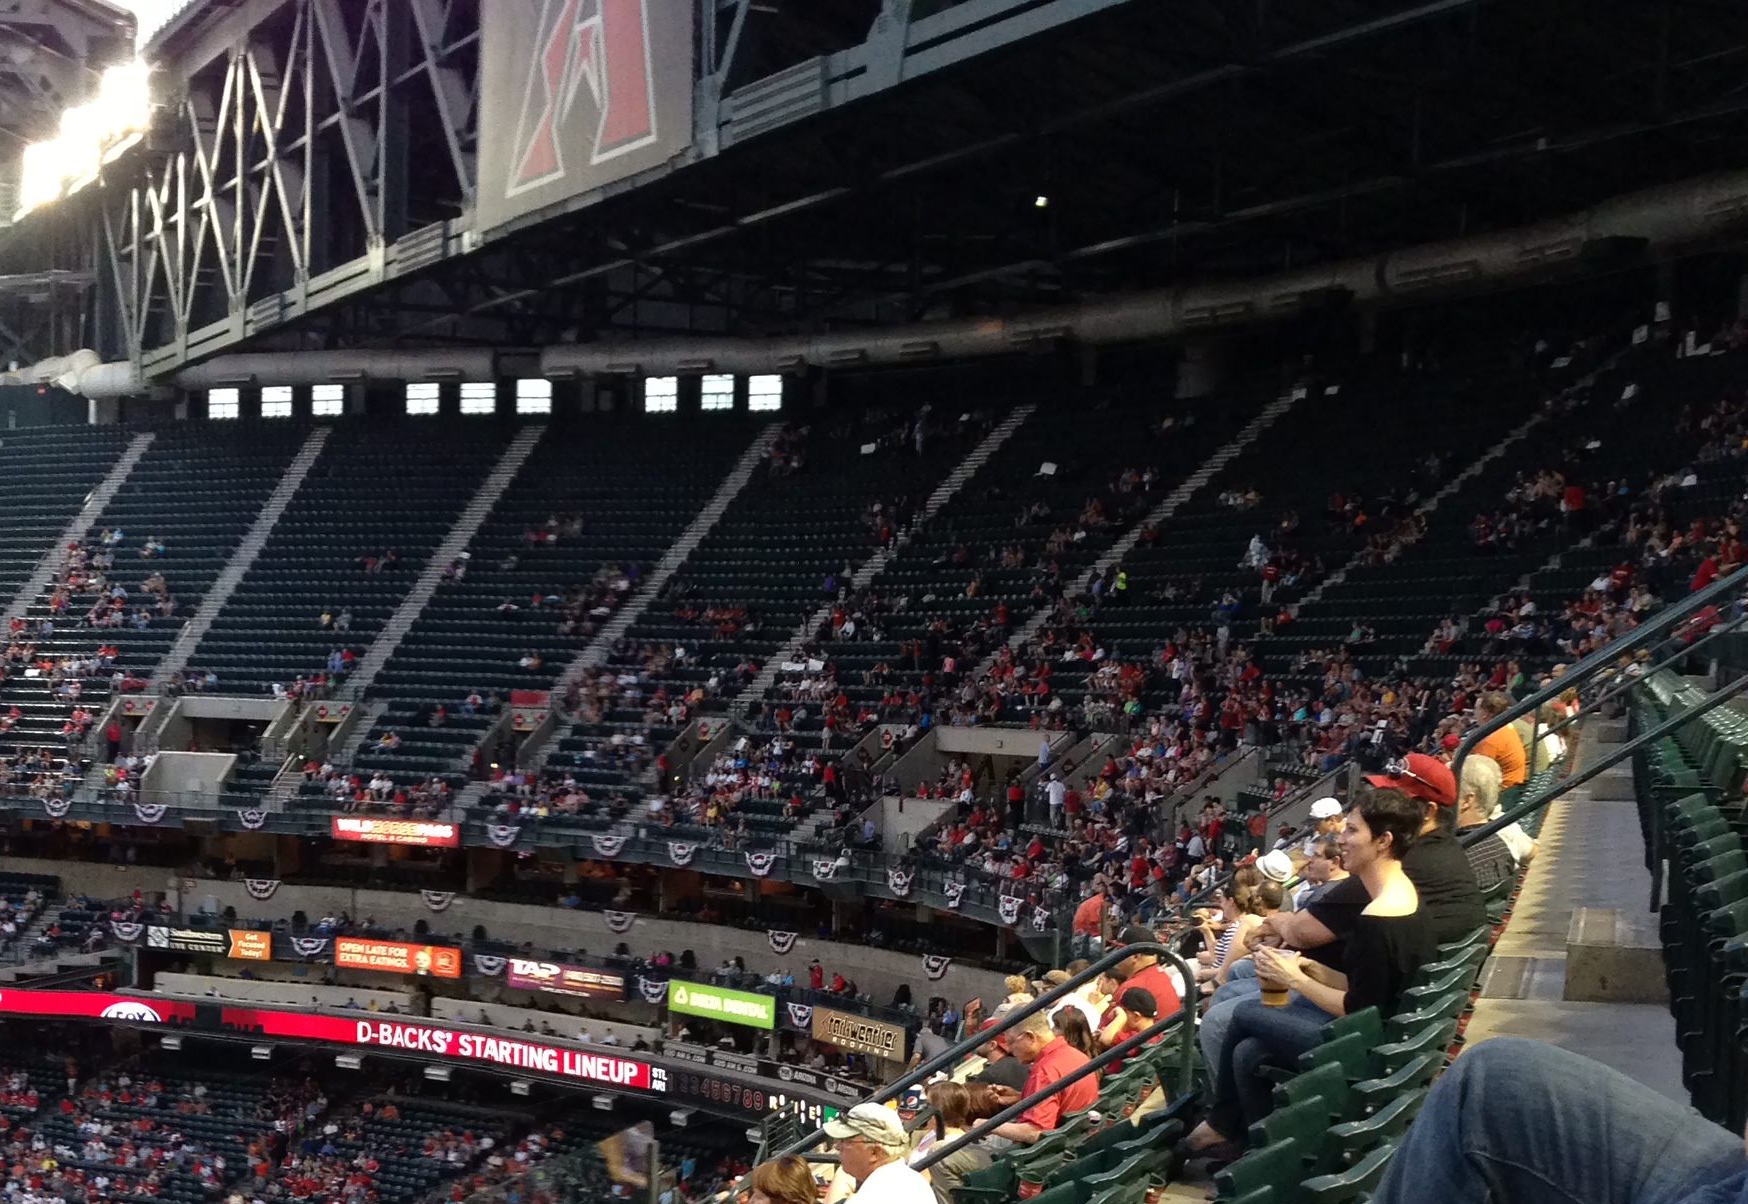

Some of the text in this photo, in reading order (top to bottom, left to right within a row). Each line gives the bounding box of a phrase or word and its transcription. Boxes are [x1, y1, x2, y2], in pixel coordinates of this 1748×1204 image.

[245, 933, 258, 942] Get
[237, 941, 266, 950] Focused
[339, 942, 409, 958] OPEN LATE FOR
[241, 949, 263, 958] Today!
[339, 951, 369, 964] EXTRA
[510, 958, 561, 978] TAP
[690, 990, 769, 1020] DELTA DENTAL
[357, 1019, 452, 1054] D-BACKS'
[458, 1033, 558, 1072] STARTING
[563, 1050, 639, 1085] LINEUP
[832, 1036, 889, 1057] ROOFING
[652, 1067, 667, 1081] STL
[652, 1079, 666, 1092] ARI
[680, 1075, 688, 1093] 2
[690, 1076, 699, 1095] 3
[700, 1078, 710, 1098] 4
[710, 1080, 720, 1100] 5
[721, 1082, 732, 1103] 6
[732, 1084, 741, 1105] 7
[742, 1088, 753, 1109] 8
[753, 1091, 764, 1111] 9
